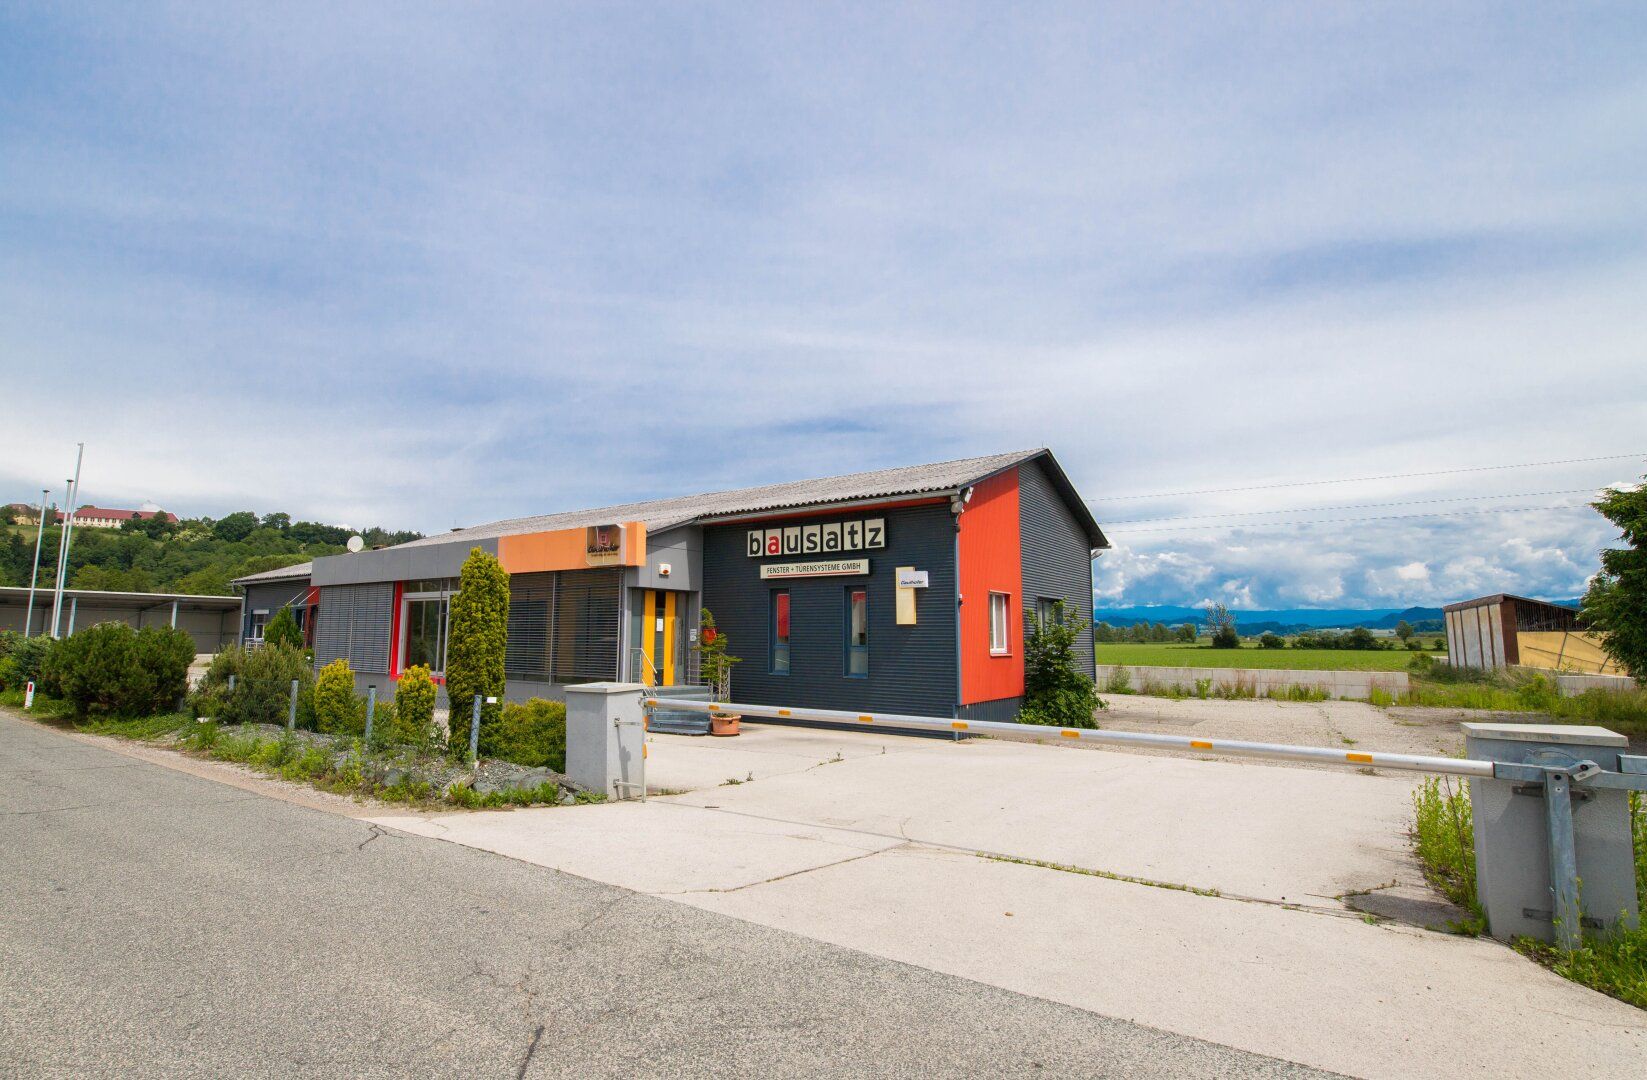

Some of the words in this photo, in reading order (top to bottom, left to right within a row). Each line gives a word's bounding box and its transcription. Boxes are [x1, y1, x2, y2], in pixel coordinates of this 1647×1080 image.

[749, 523, 882, 555] bausatz
[766, 566, 790, 574] FENSTER
[842, 562, 861, 571] GMBH
